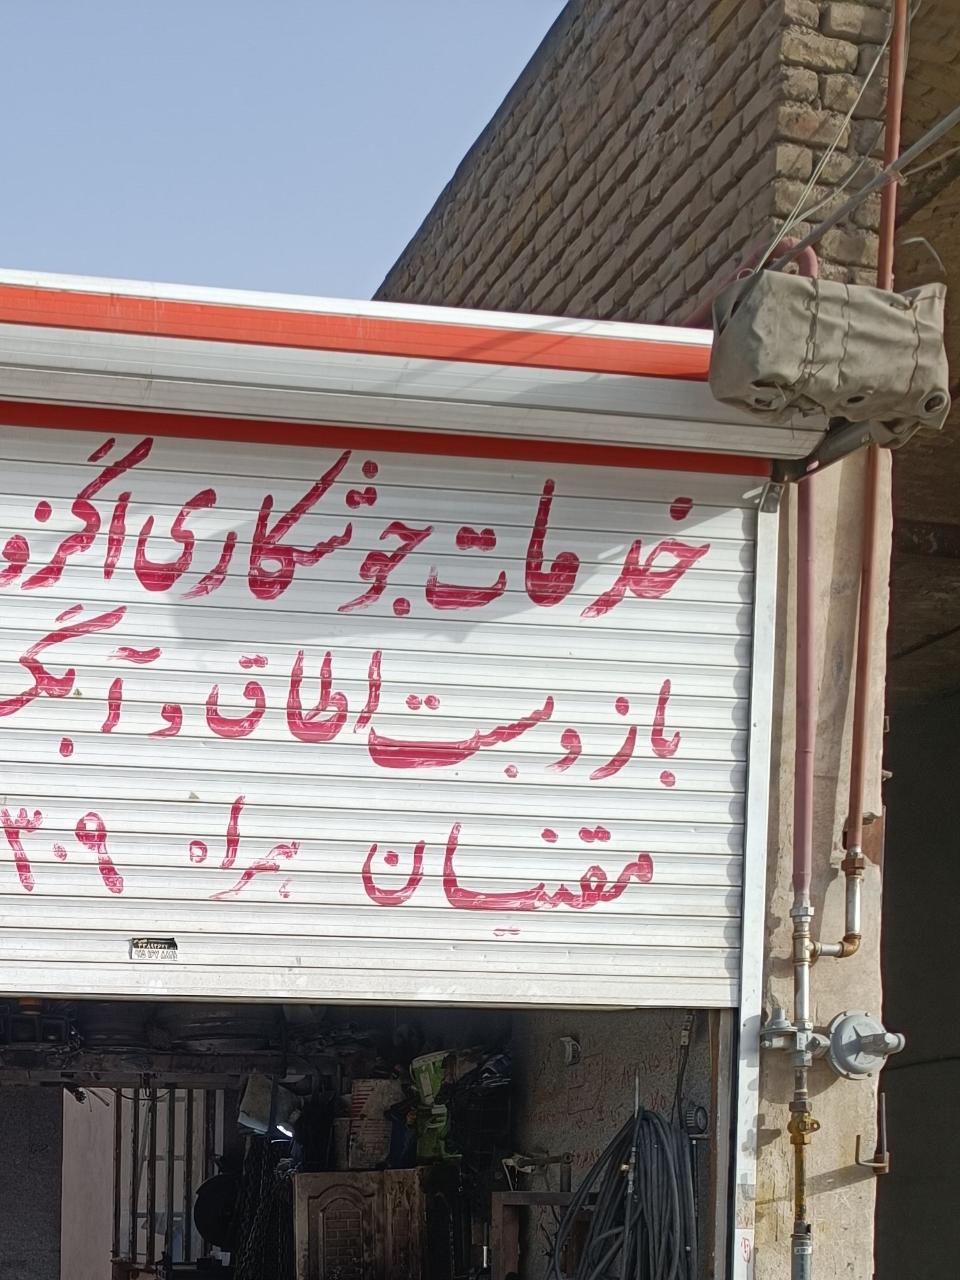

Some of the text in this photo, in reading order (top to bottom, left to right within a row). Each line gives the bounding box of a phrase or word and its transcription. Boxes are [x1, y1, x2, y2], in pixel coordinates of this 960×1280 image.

[134, 449, 432, 613] جوشکاری
[426, 480, 710, 618] خدمات
[205, 649, 382, 744] اطاق
